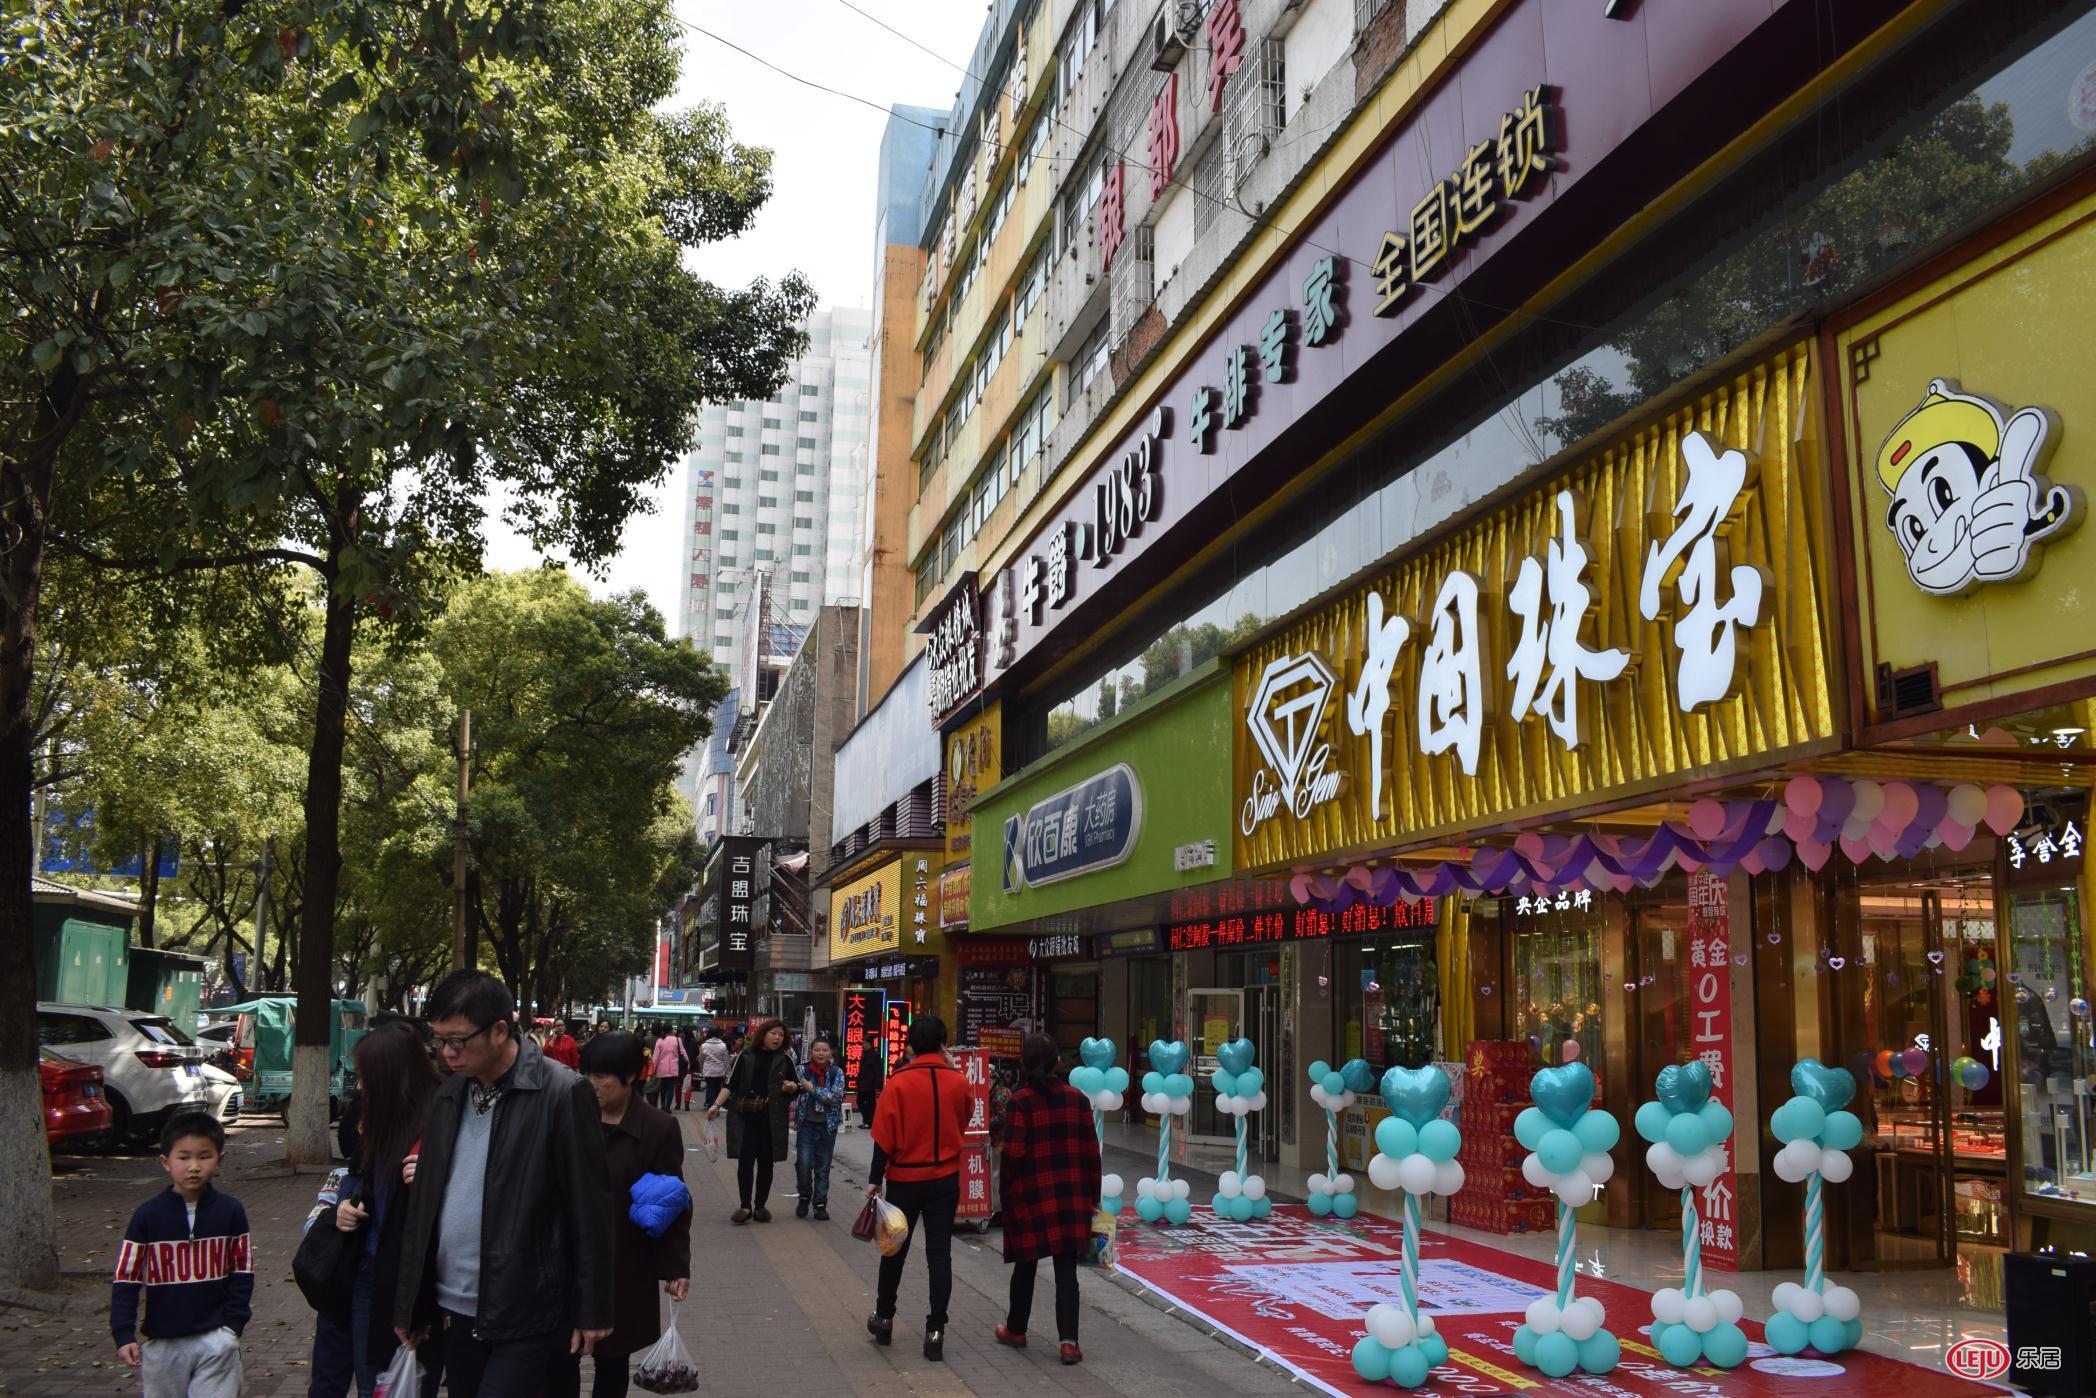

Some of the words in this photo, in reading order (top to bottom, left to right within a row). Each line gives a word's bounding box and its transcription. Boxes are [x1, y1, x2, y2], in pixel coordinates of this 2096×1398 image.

[1190, 256, 1337, 454] 牛排专家
[1370, 84, 1548, 317] 全国连锁
[1347, 431, 1763, 822] 中国珠宝
[1027, 805, 1079, 869] 欣百康
[1083, 788, 1117, 833] 大药房
[729, 856, 751, 951] 吉盟珠宝
[1515, 888, 1592, 916] 央企品牌
[1690, 938, 1728, 968] 黄金
[845, 993, 866, 1078] 大众眼镜城
